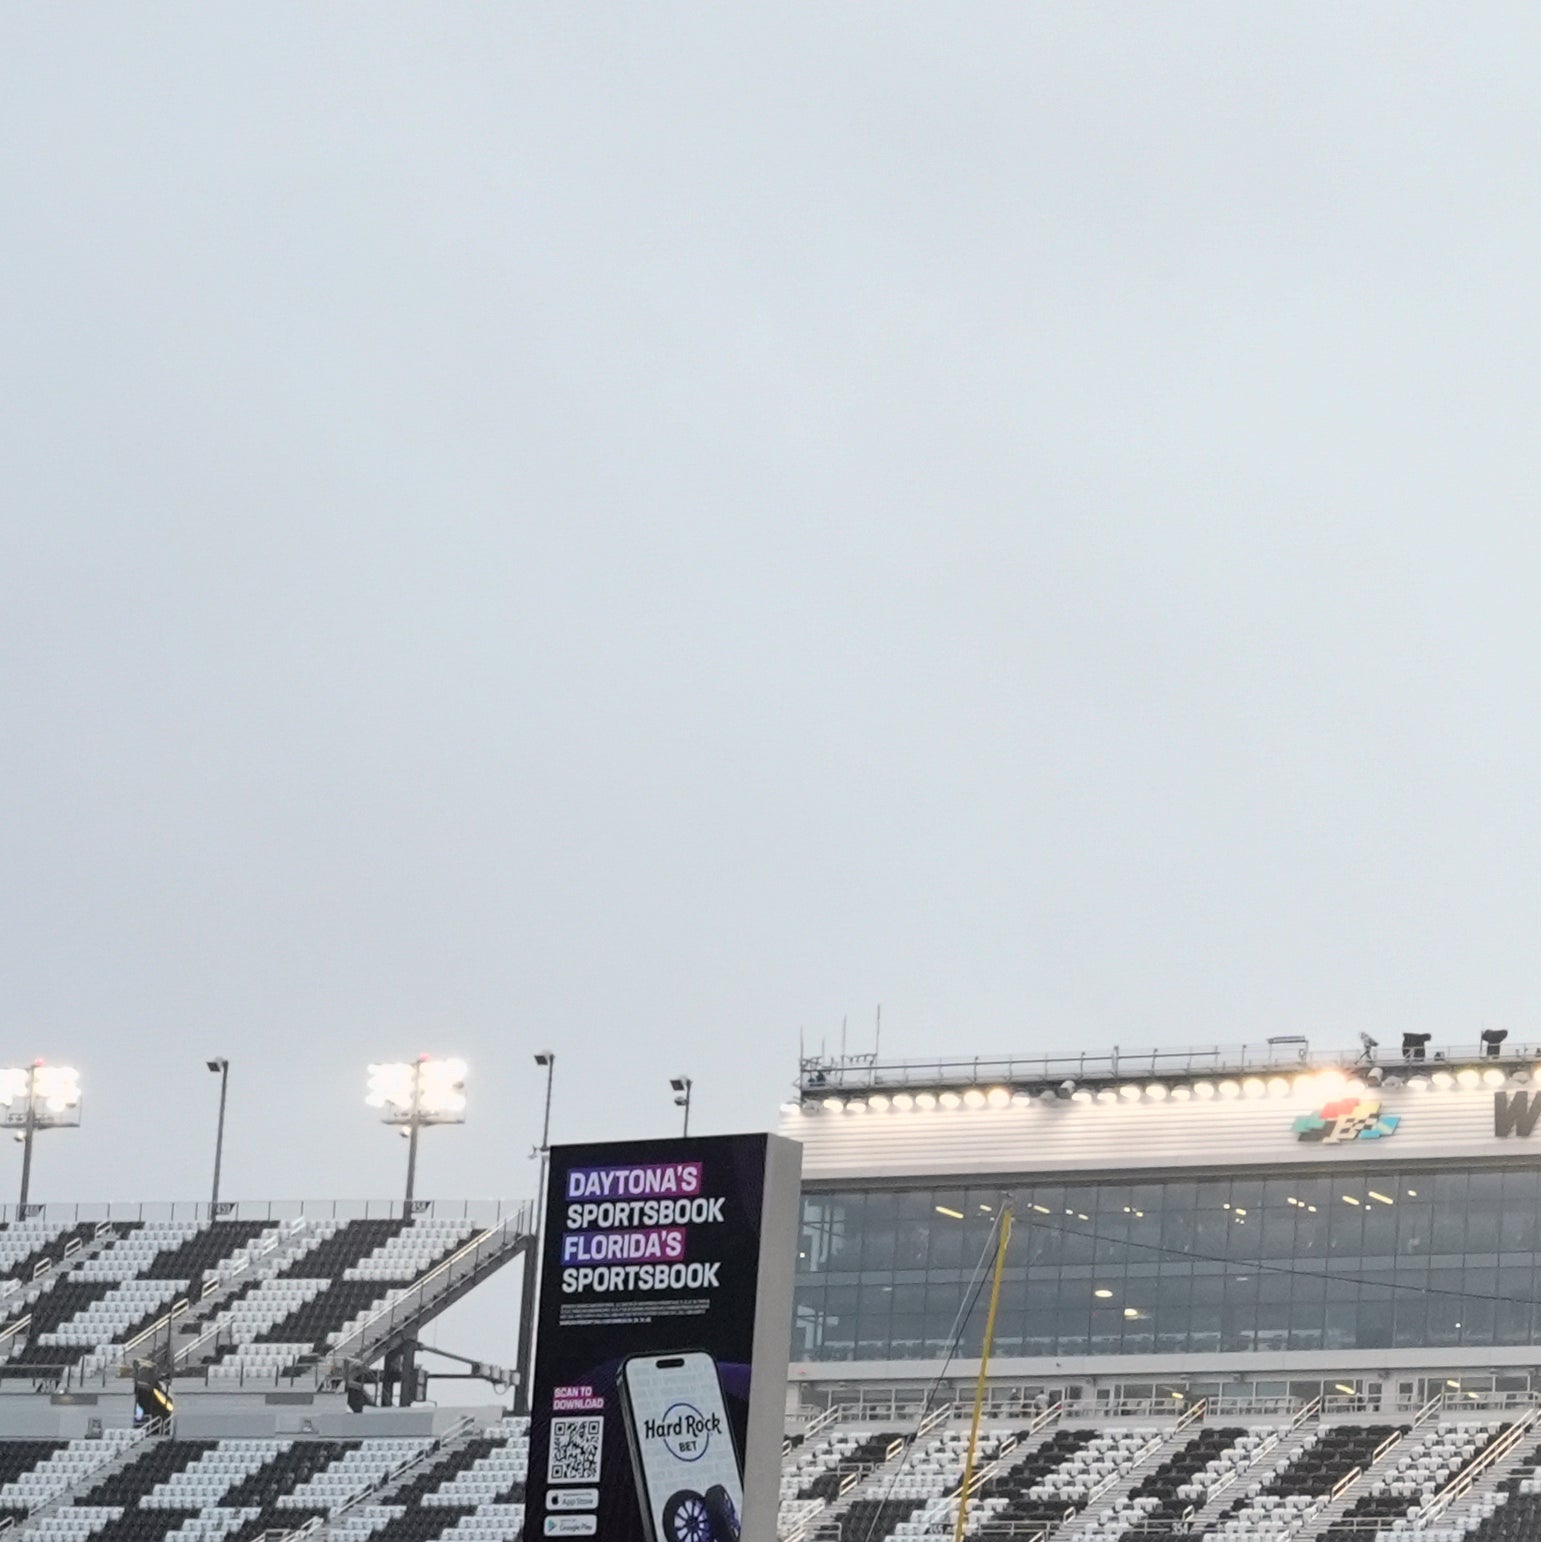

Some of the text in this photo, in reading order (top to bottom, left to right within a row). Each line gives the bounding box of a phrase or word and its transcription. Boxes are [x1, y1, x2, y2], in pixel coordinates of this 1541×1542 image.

[569, 1165, 698, 1197] DAYTONA'S
[566, 1197, 726, 1229] SPORTSBOOK
[564, 1231, 682, 1261] FLORIDA'S
[561, 1262, 721, 1294] SPORTSBOOK
[552, 1398, 604, 1410] DOWNLOAD
[554, 1386, 593, 1399] SCAN TO
[644, 1412, 722, 1440] Hard Rock
[678, 1440, 698, 1453] BET
